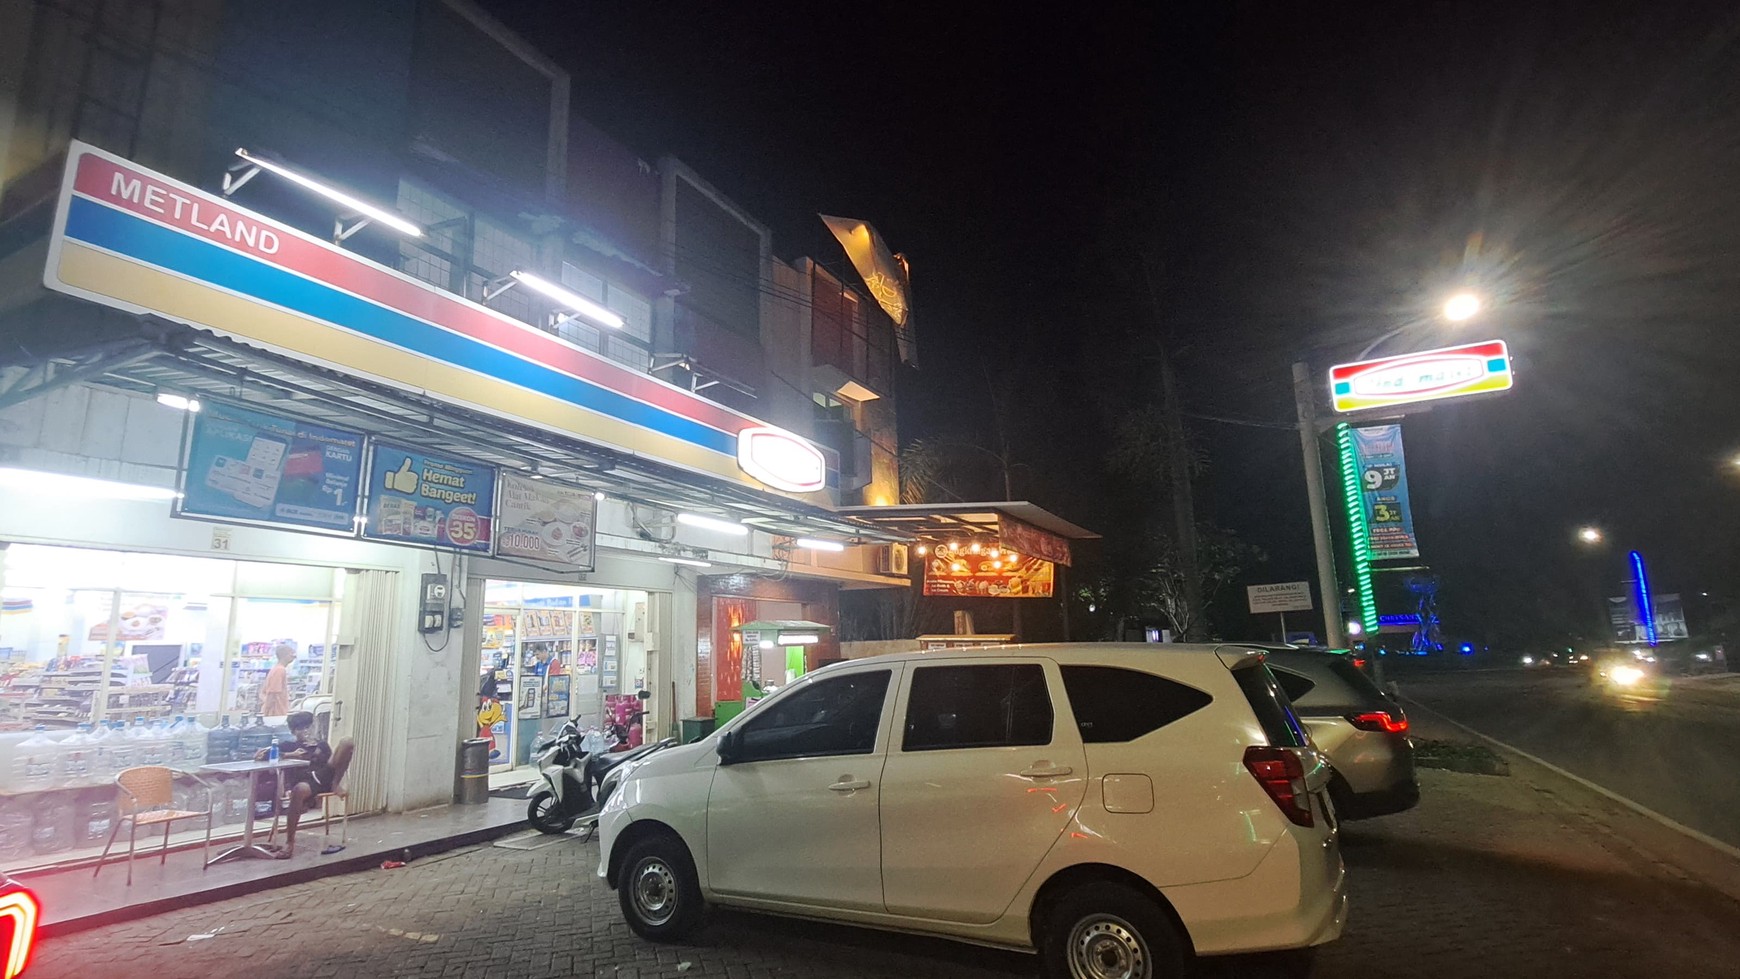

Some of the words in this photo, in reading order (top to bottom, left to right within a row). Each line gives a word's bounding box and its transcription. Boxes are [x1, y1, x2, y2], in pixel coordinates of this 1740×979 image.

[111, 171, 280, 254] METLAND
[325, 451, 352, 462] KARTU
[422, 468, 465, 488] Hemat
[1364, 470, 1383, 490] 9
[421, 483, 477, 505] Bangeet!
[1374, 504, 1390, 522] 3
[450, 521, 477, 540] 35
[214, 538, 228, 550] 31
[509, 533, 540, 550] 10.000
